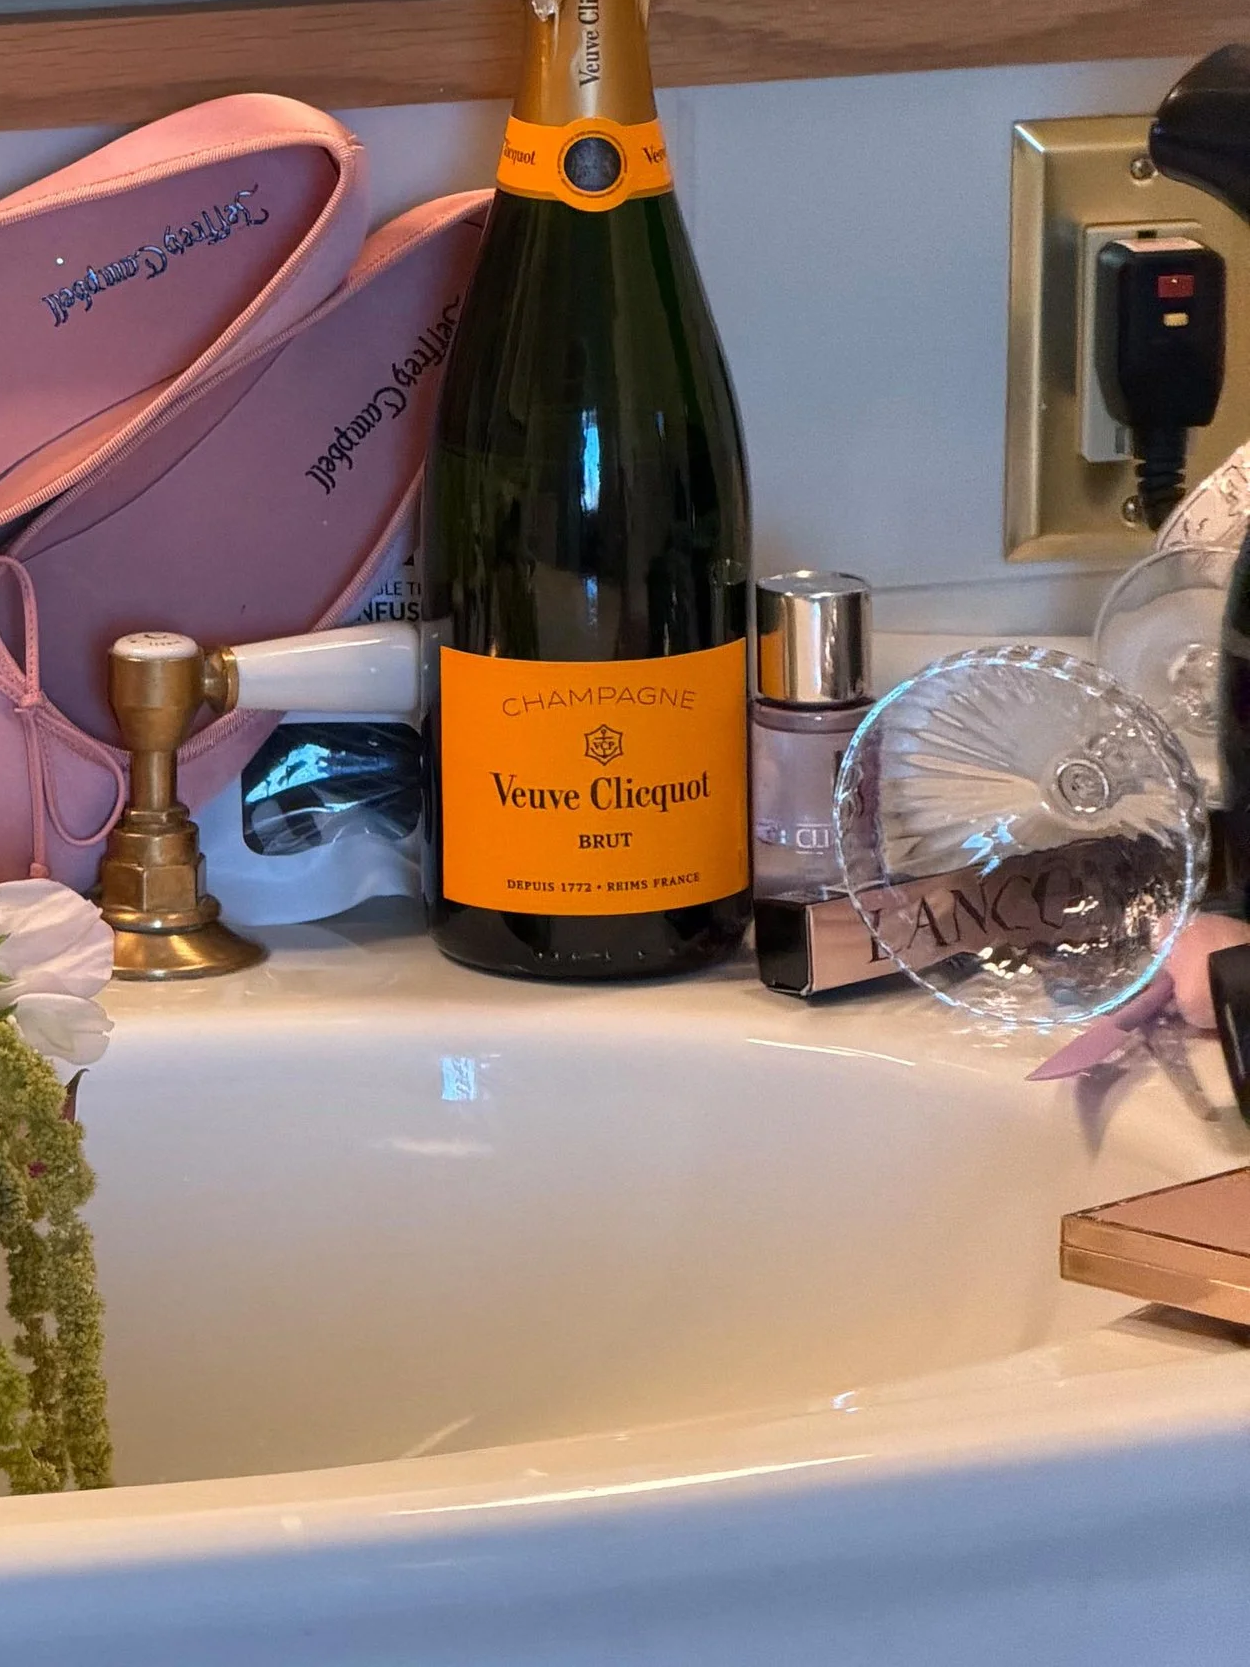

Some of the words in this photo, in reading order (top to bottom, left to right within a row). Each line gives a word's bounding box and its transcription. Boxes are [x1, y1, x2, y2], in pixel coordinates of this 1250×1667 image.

[578, 30, 600, 88] Veuve
[163, 182, 270, 255] Jeffrey
[41, 244, 168, 327] Campbell
[304, 386, 407, 495] Campbell
[502, 686, 697, 716] CHAMPAGNE
[489, 771, 581, 811] Veuve
[589, 769, 712, 813] Clicquot
[578, 832, 633, 849] BRUT
[507, 878, 555, 893] DEPUIS
[561, 882, 592, 894] 1772
[607, 878, 649, 892] REIMS
[653, 870, 701, 889] FRANCE
